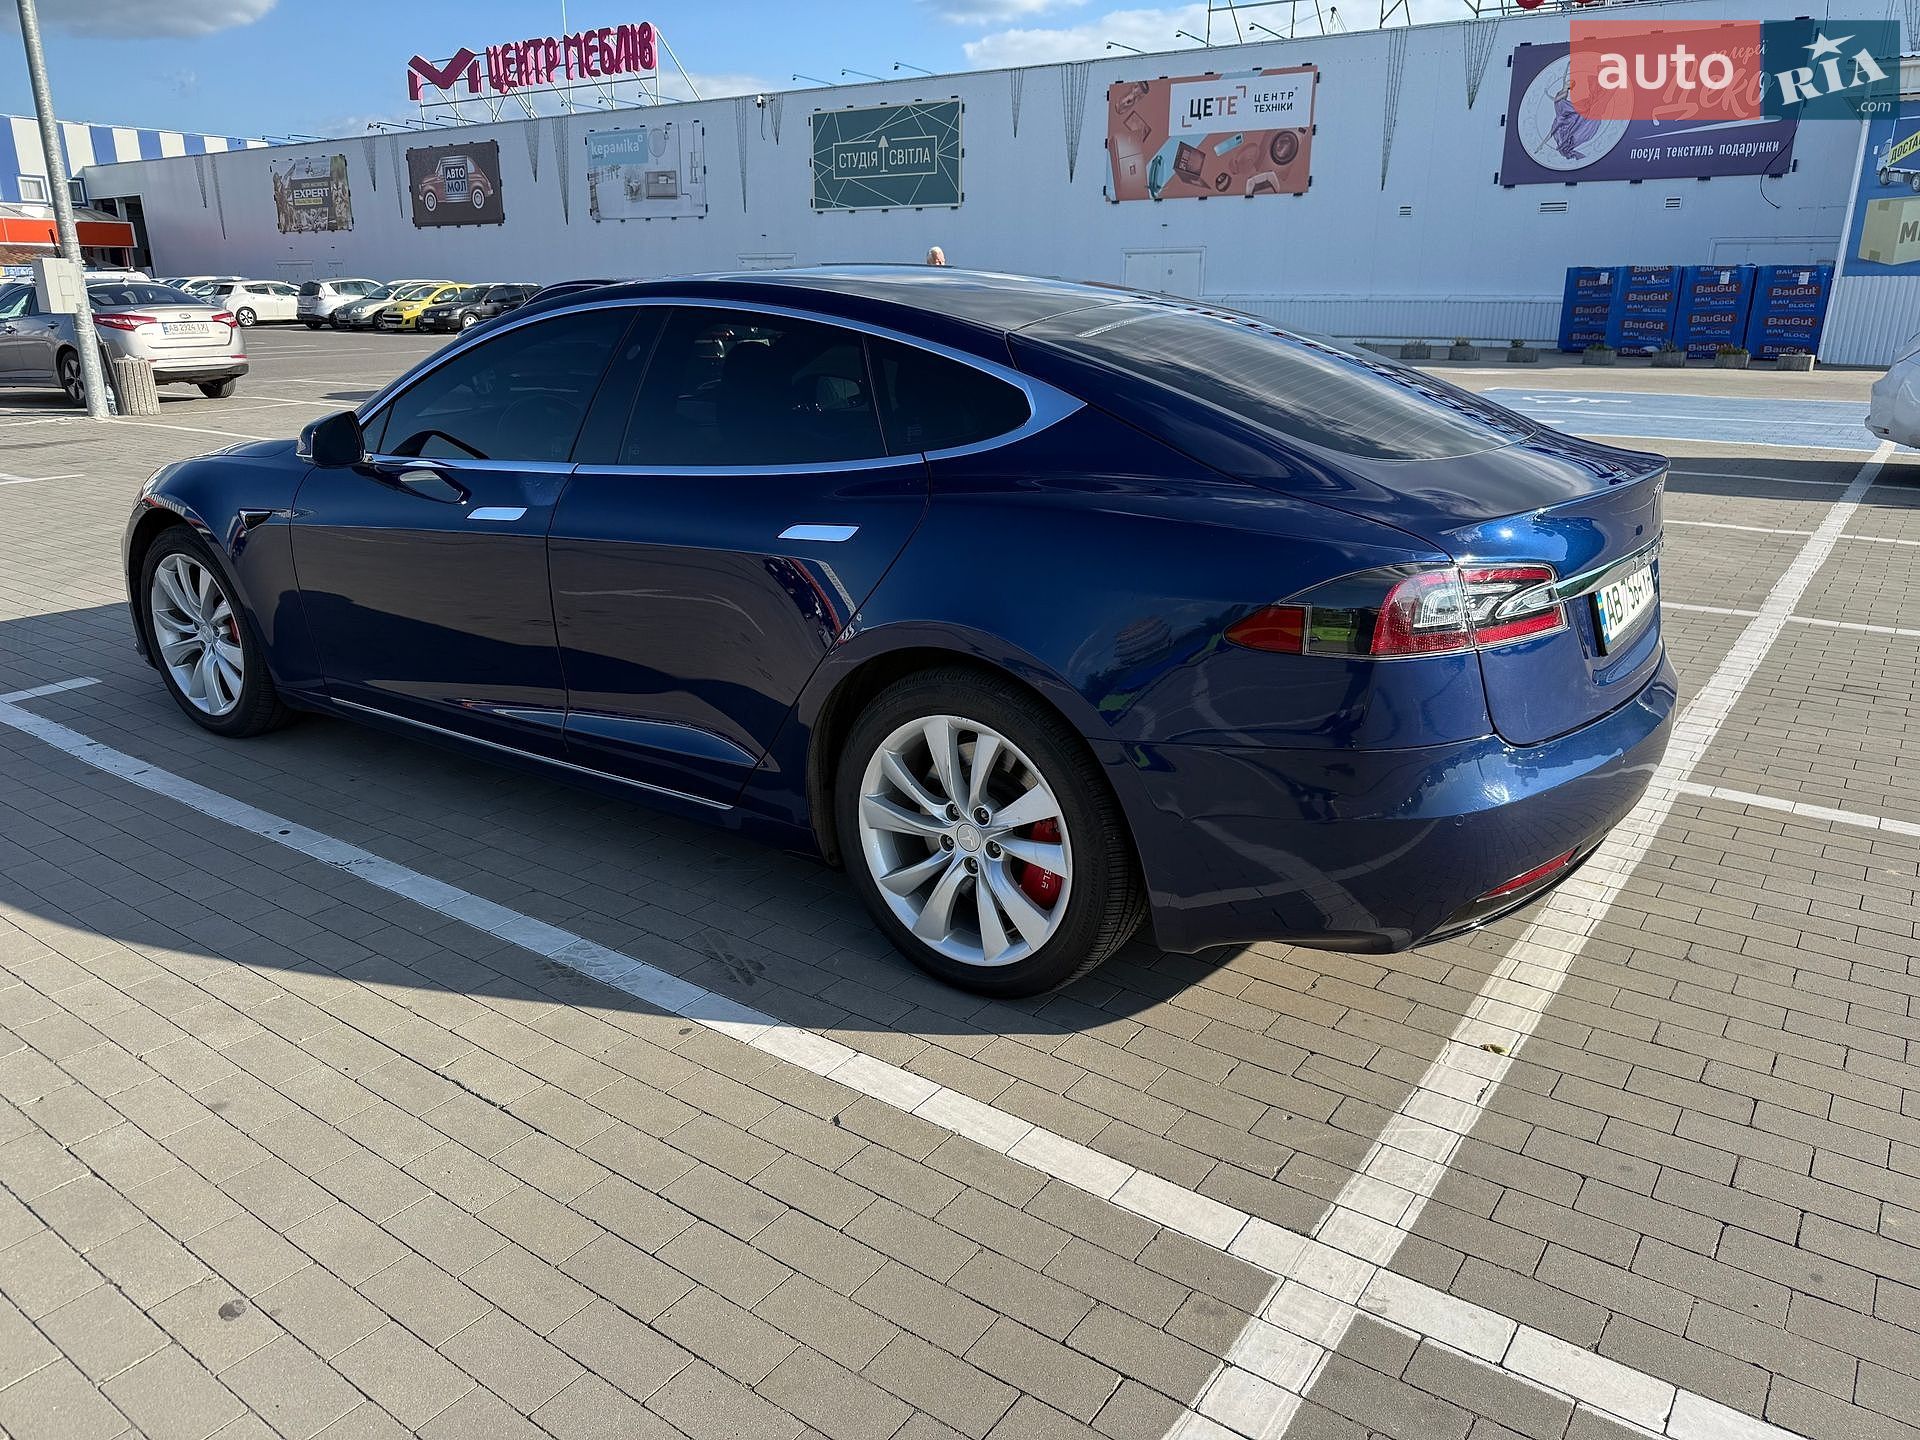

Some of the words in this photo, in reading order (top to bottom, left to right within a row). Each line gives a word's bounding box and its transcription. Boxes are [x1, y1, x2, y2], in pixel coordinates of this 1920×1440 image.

[486, 37, 561, 94] ЦЕНТР
[563, 21, 657, 80] МЕБЛІВ
[1254, 91, 1295, 102] ЦЕНТР
[1189, 95, 1238, 119] ЦЕТЕ
[1254, 102, 1293, 113] ТЕХНІКИ
[889, 147, 931, 165] СВІТЛА
[1630, 147, 1660, 162] посуд
[1666, 144, 1714, 158] текстиль
[1719, 140, 1780, 157] подарунки
[839, 151, 878, 169] СТУДІЯ
[446, 167, 465, 179] АВТО
[294, 187, 330, 198] EXPERT
[447, 182, 467, 192] МОЛ
[1696, 284, 1737, 293] BauGut
[1772, 286, 1817, 296] BauGut
[1628, 293, 1668, 301] BauGut
[1576, 305, 1608, 314] BauGu
[1692, 314, 1732, 323] BauGut
[1767, 317, 1813, 326] BauGut
[1623, 320, 1664, 330] BauGut
[1606, 585, 1623, 631] AB
